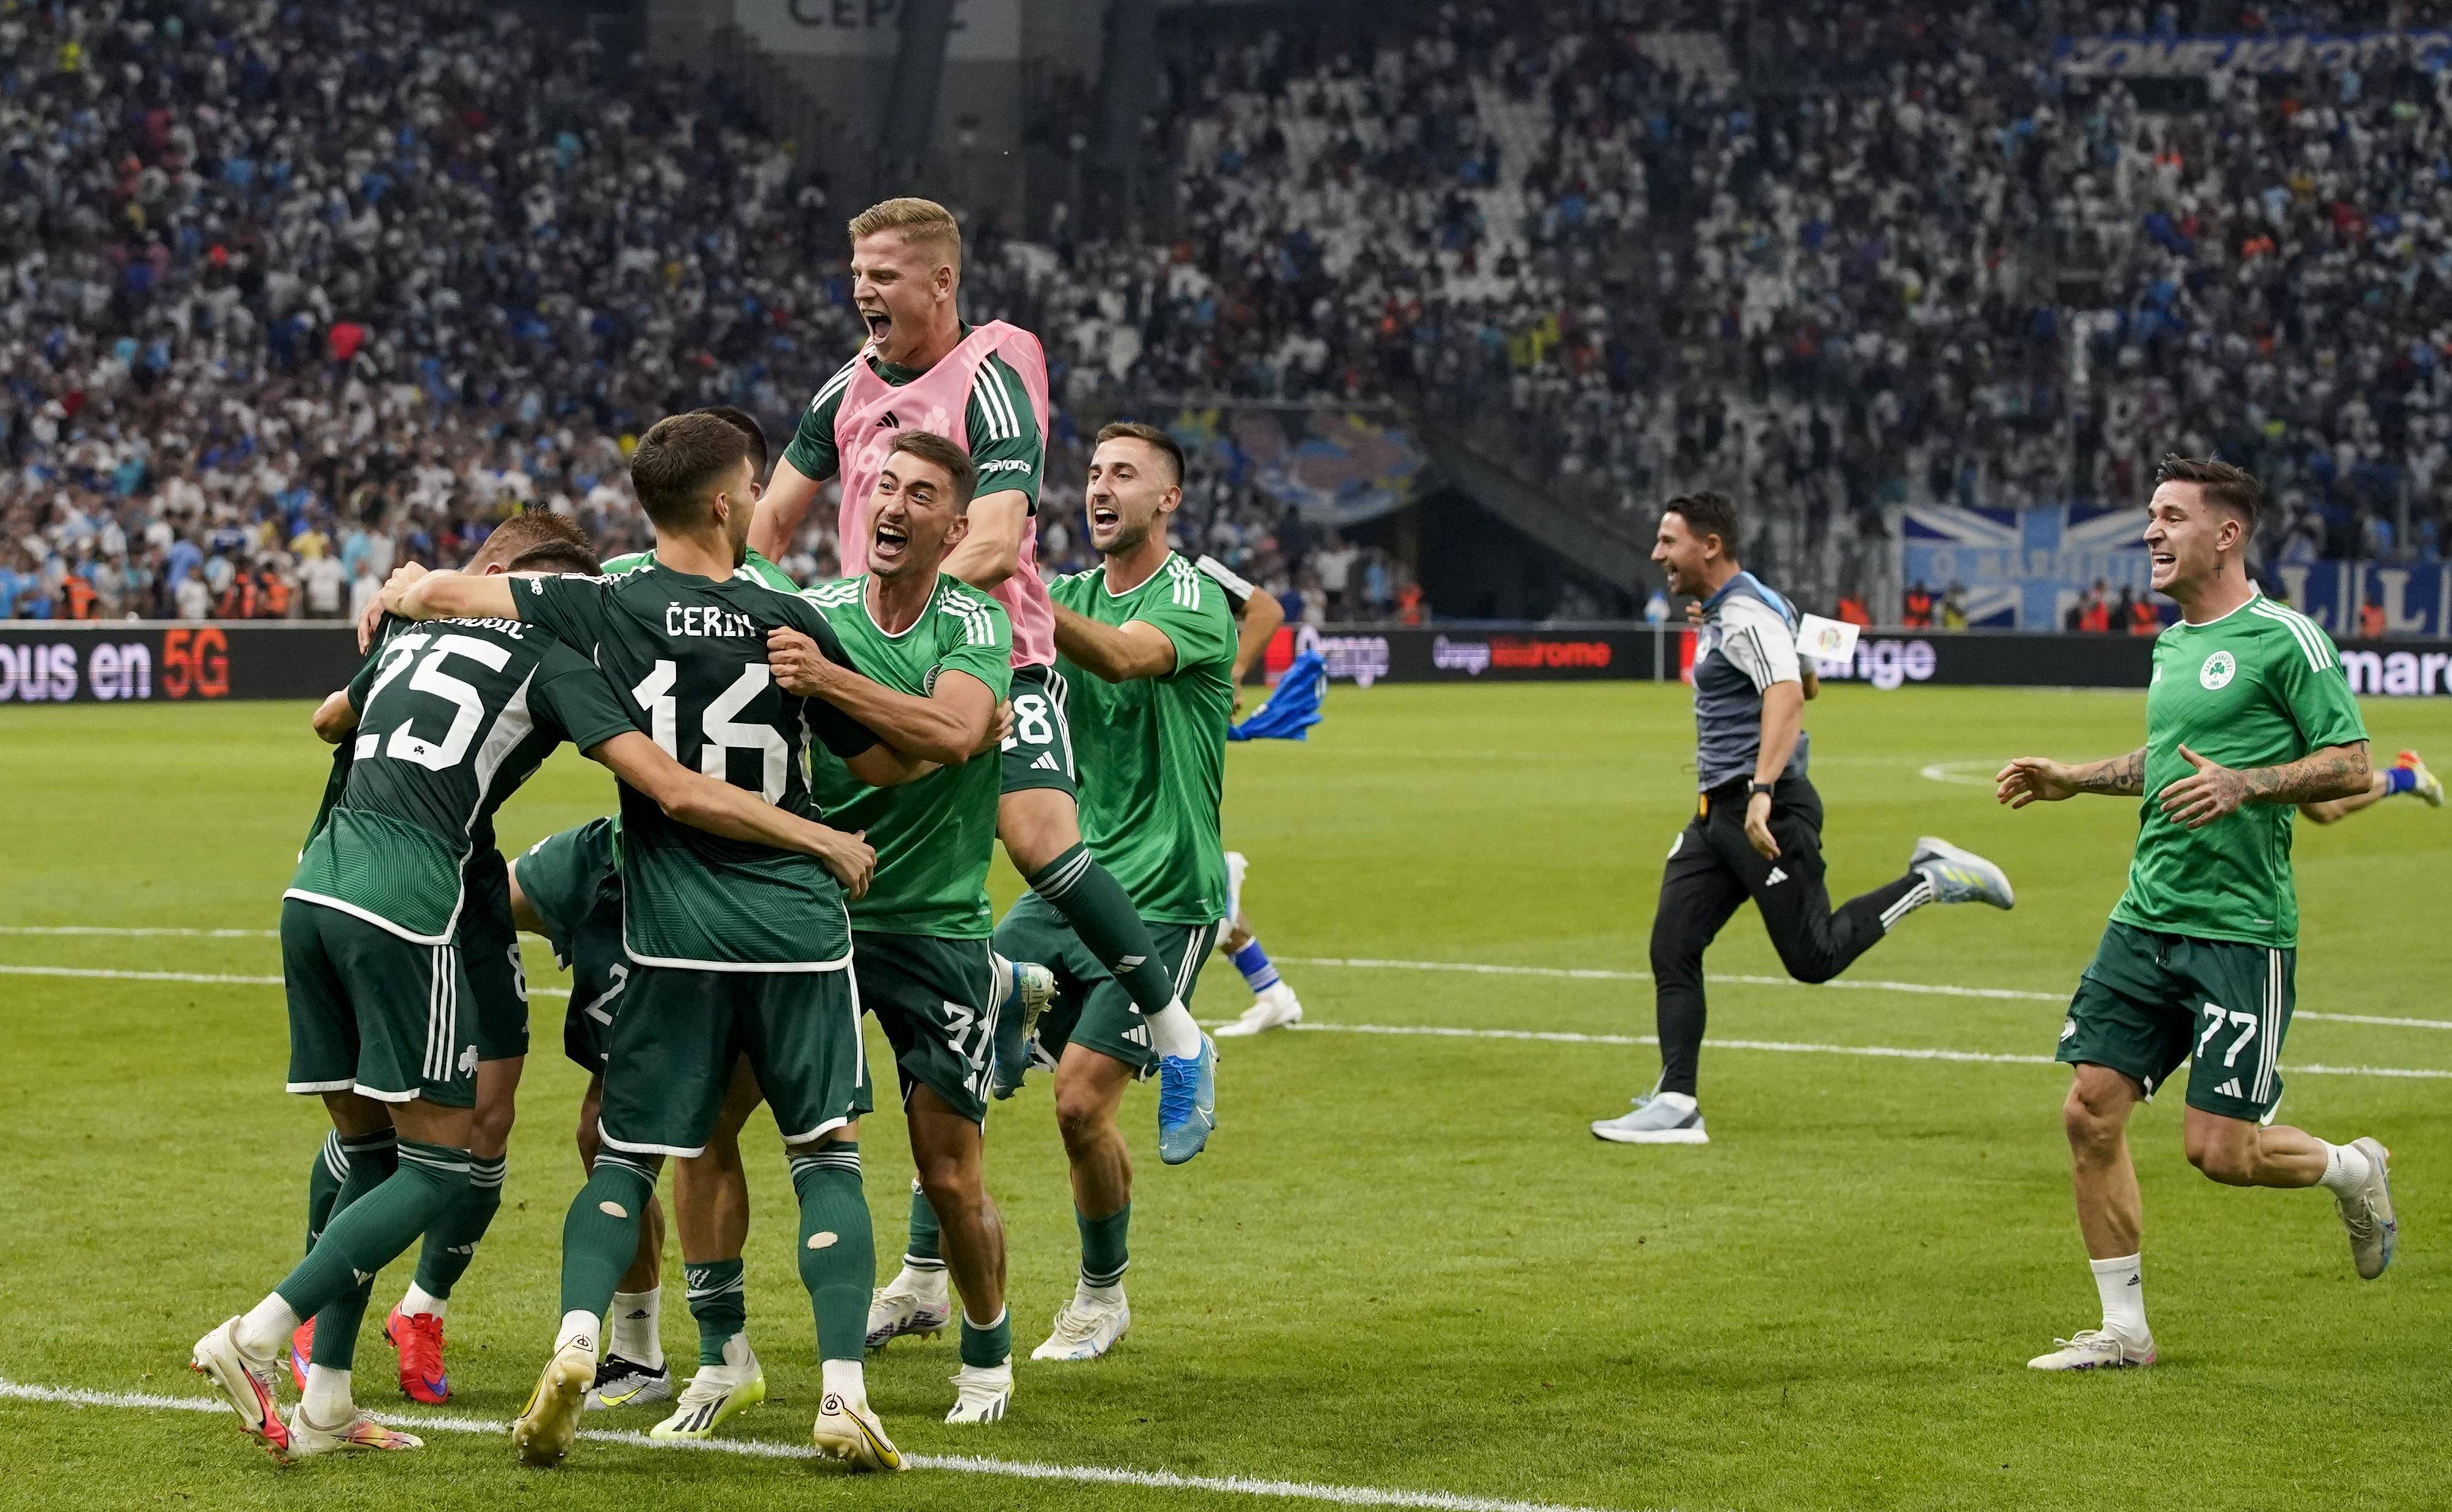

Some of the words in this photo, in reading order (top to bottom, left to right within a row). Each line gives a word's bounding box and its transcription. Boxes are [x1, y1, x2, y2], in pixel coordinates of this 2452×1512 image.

[666, 601, 757, 637] ČERIN
[88, 642, 152, 700] en
[163, 627, 229, 698] 5G
[2338, 650, 2452, 696] mar
[353, 633, 512, 772] 25
[631, 658, 788, 806] 16
[1001, 694, 1054, 752] 8
[2196, 1001, 2258, 1068] 77
